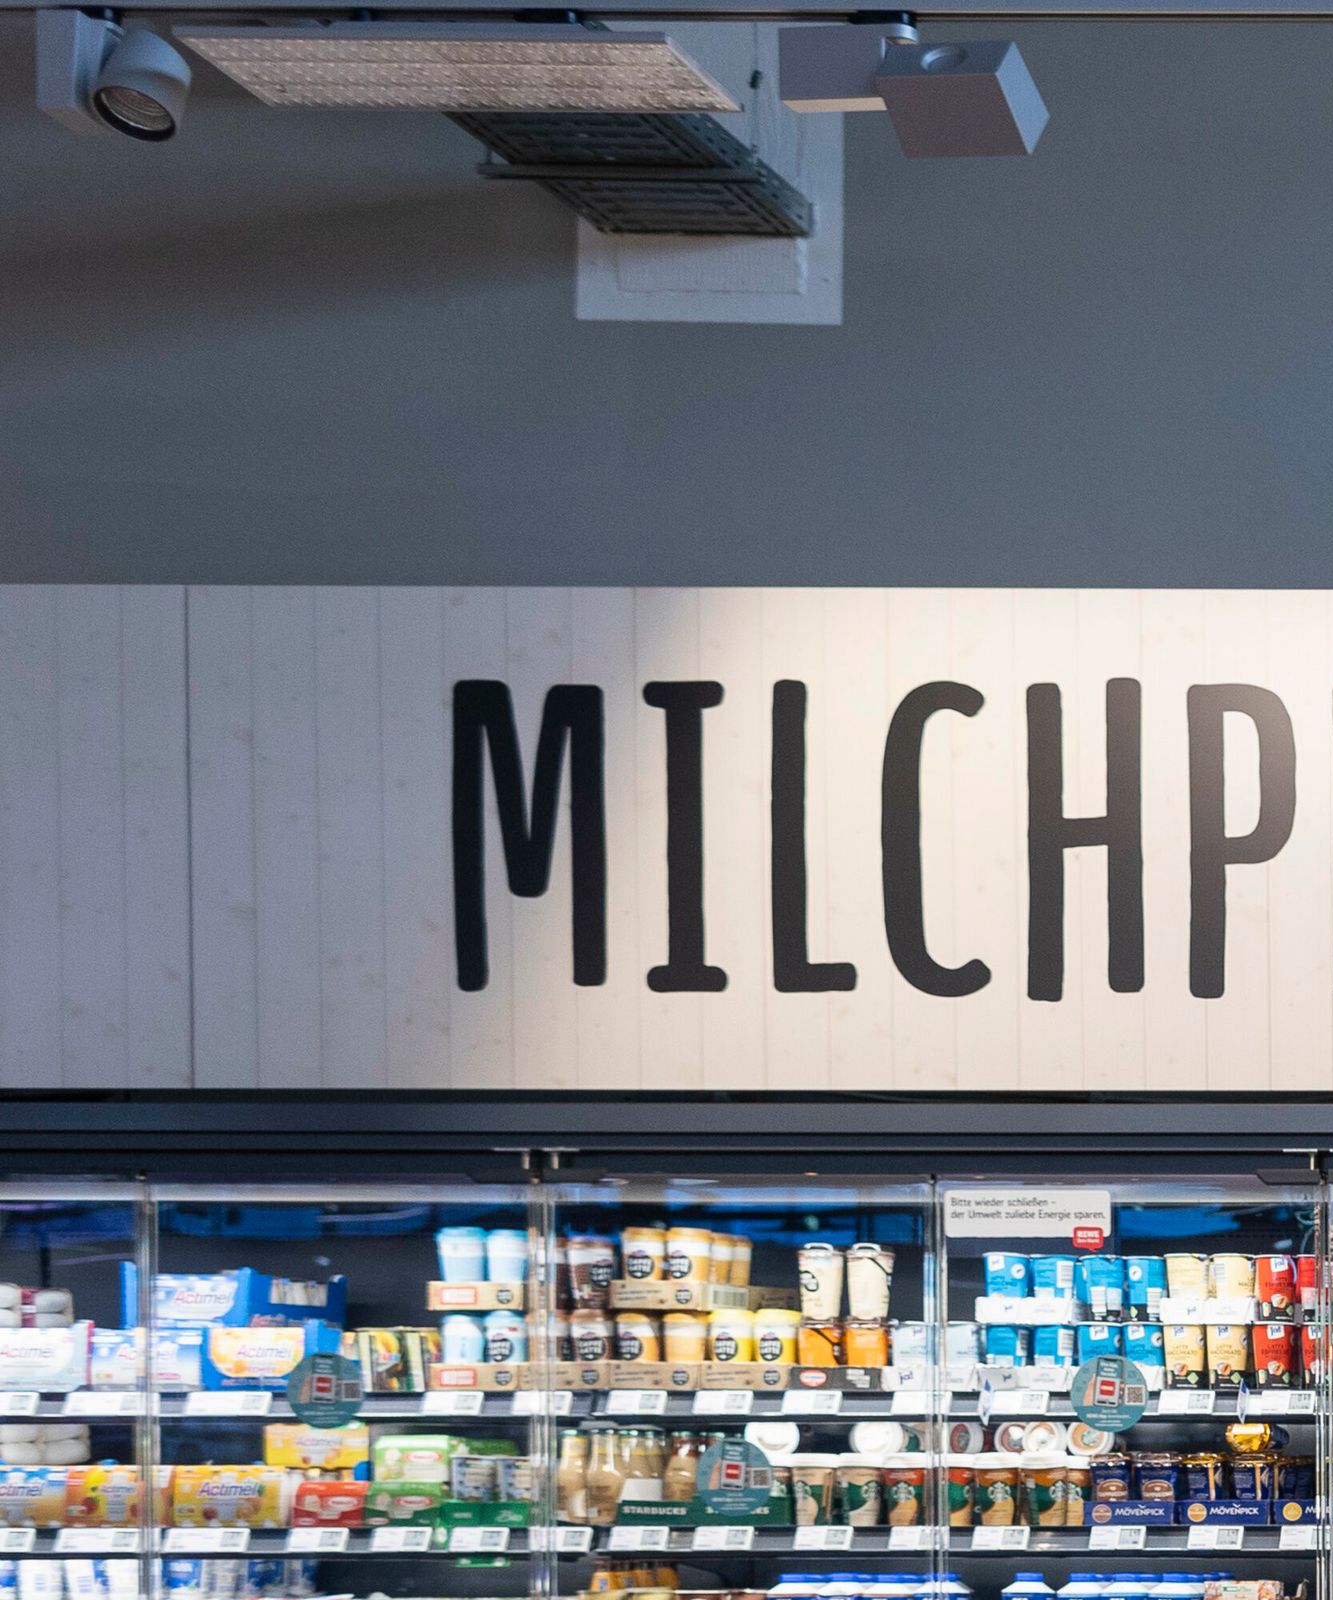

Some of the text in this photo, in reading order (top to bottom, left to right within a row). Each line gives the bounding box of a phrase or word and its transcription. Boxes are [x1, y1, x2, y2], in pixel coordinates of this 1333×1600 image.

[950, 1197, 971, 1207] Bitte
[975, 1197, 1004, 1206] wieder
[950, 1210, 1106, 1221] der Umwelt zuliebe Energie sparen.
[200, 1481, 259, 1499] Actimel
[623, 1506, 687, 1516] STARBUCKS
[1115, 1504, 1165, 1517] MÖVENPICK
[1209, 1503, 1259, 1516] MÖVENPICK
